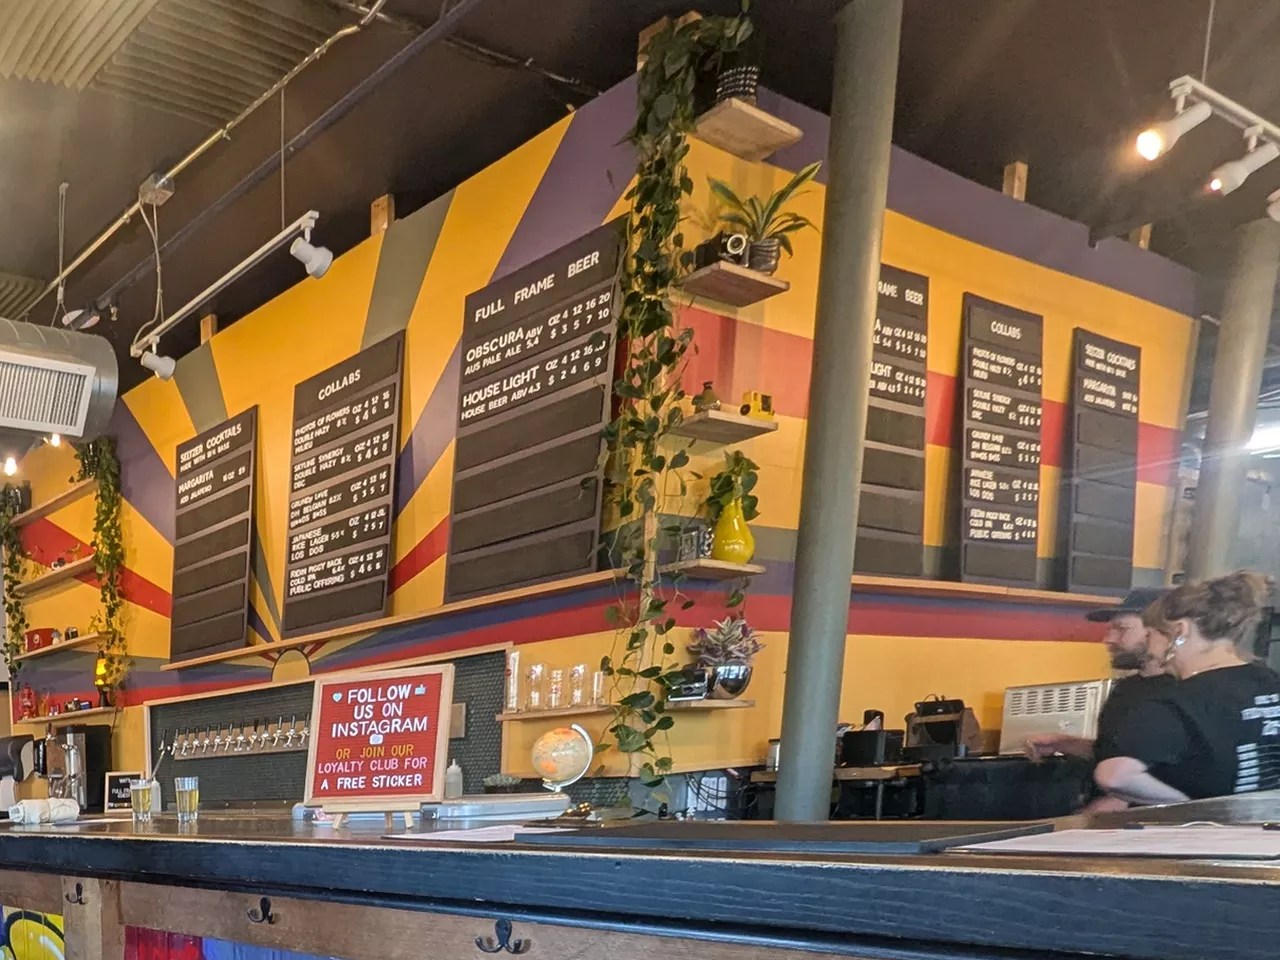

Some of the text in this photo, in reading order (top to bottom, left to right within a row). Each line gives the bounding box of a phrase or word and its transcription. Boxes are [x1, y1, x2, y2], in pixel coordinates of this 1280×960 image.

[475, 251, 600, 322] FULL FRAME BEER
[905, 288, 924, 305] BEER
[466, 292, 610, 362] OBSCURA ABV OZ 4 12 16 20
[990, 320, 1021, 340] COLLABS
[465, 308, 609, 376] AUS PALE ALE 5.4 $ 3 5 7 10
[318, 369, 361, 401] COLLABS
[463, 384, 500, 407] HOUSE
[503, 365, 539, 392] LIGHT
[545, 359, 558, 371] OZ
[561, 355, 567, 364] 4
[570, 350, 580, 361] 12
[583, 345, 593, 357] 16
[461, 403, 485, 420] HOUSE
[488, 394, 508, 410] BEER
[511, 387, 528, 401] ABV
[548, 375, 555, 386] $
[560, 370, 566, 380] 2
[570, 365, 577, 374] 4
[583, 362, 590, 372] 6
[594, 357, 602, 367] 9
[325, 405, 351, 423] FLOWERS
[352, 403, 363, 414] OZ
[371, 395, 379, 405] 12
[206, 423, 242, 449] COCKTAILS
[294, 431, 314, 446] DOUBLE
[314, 425, 330, 437] HAZY
[362, 410, 369, 420] 4
[371, 406, 377, 414] 6
[293, 458, 316, 473] SKYLINE
[318, 447, 344, 463] SYNERGY
[354, 442, 365, 453] OZ
[293, 466, 317, 481] DOUBLE
[319, 459, 337, 472] HAZY
[365, 449, 372, 459] 4
[373, 447, 378, 456] 6
[178, 469, 214, 494] MARGARITA
[350, 481, 362, 492] OZ
[303, 499, 327, 514] BELGIAN
[291, 527, 322, 544] JAPANESE
[349, 516, 360, 527] OZ
[291, 541, 306, 552] RICE
[309, 534, 329, 547] LAGER
[291, 544, 324, 561] LOS DOS
[289, 576, 306, 587] COLD
[307, 573, 317, 582] IPA
[358, 563, 365, 574] 4
[367, 563, 373, 572] 6
[308, 562, 326, 573] PIGGY
[326, 558, 343, 568] BACK
[348, 555, 359, 565] OZ
[289, 574, 345, 596] PUBLIC OFFERING
[348, 684, 412, 704] FOLLOW
[353, 702, 403, 720] US ON
[331, 716, 428, 738] INSTAGRAM
[336, 743, 415, 760] OR JOIN OUR
[317, 756, 428, 774] LOYALTY CLUB FOR
[321, 773, 423, 790] A FREE STICKER
